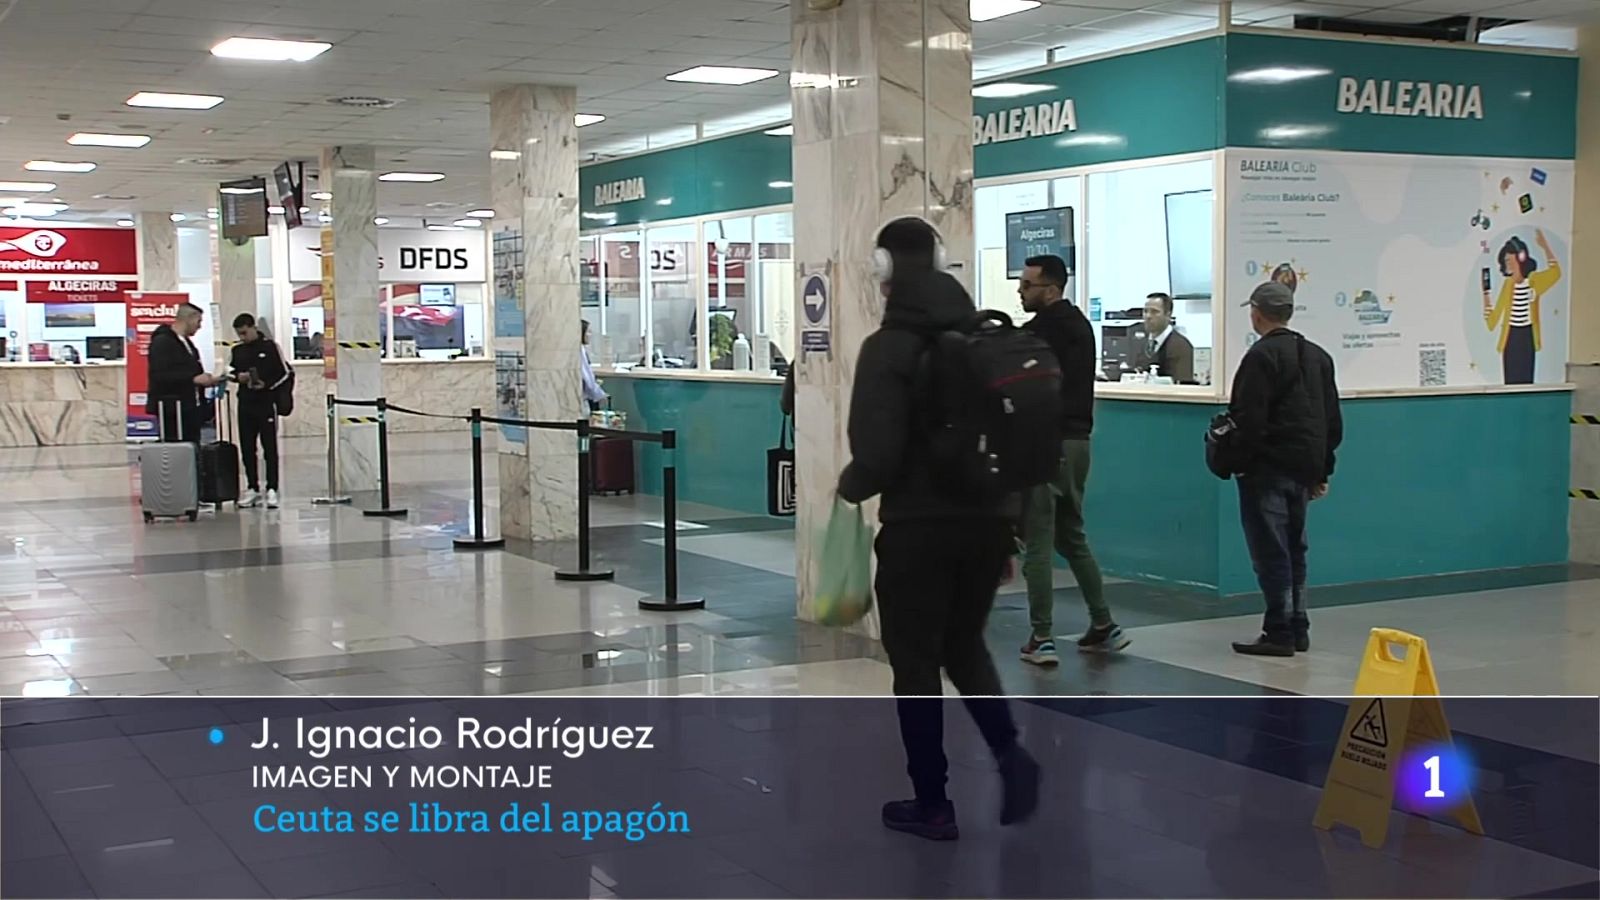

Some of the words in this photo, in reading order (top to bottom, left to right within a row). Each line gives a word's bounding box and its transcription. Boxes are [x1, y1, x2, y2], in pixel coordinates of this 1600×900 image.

[1291, 161, 1317, 173] Club
[1020, 227, 1055, 241] Algeciras
[400, 247, 468, 269] DFDS
[48, 280, 118, 291] ALGECIRAS
